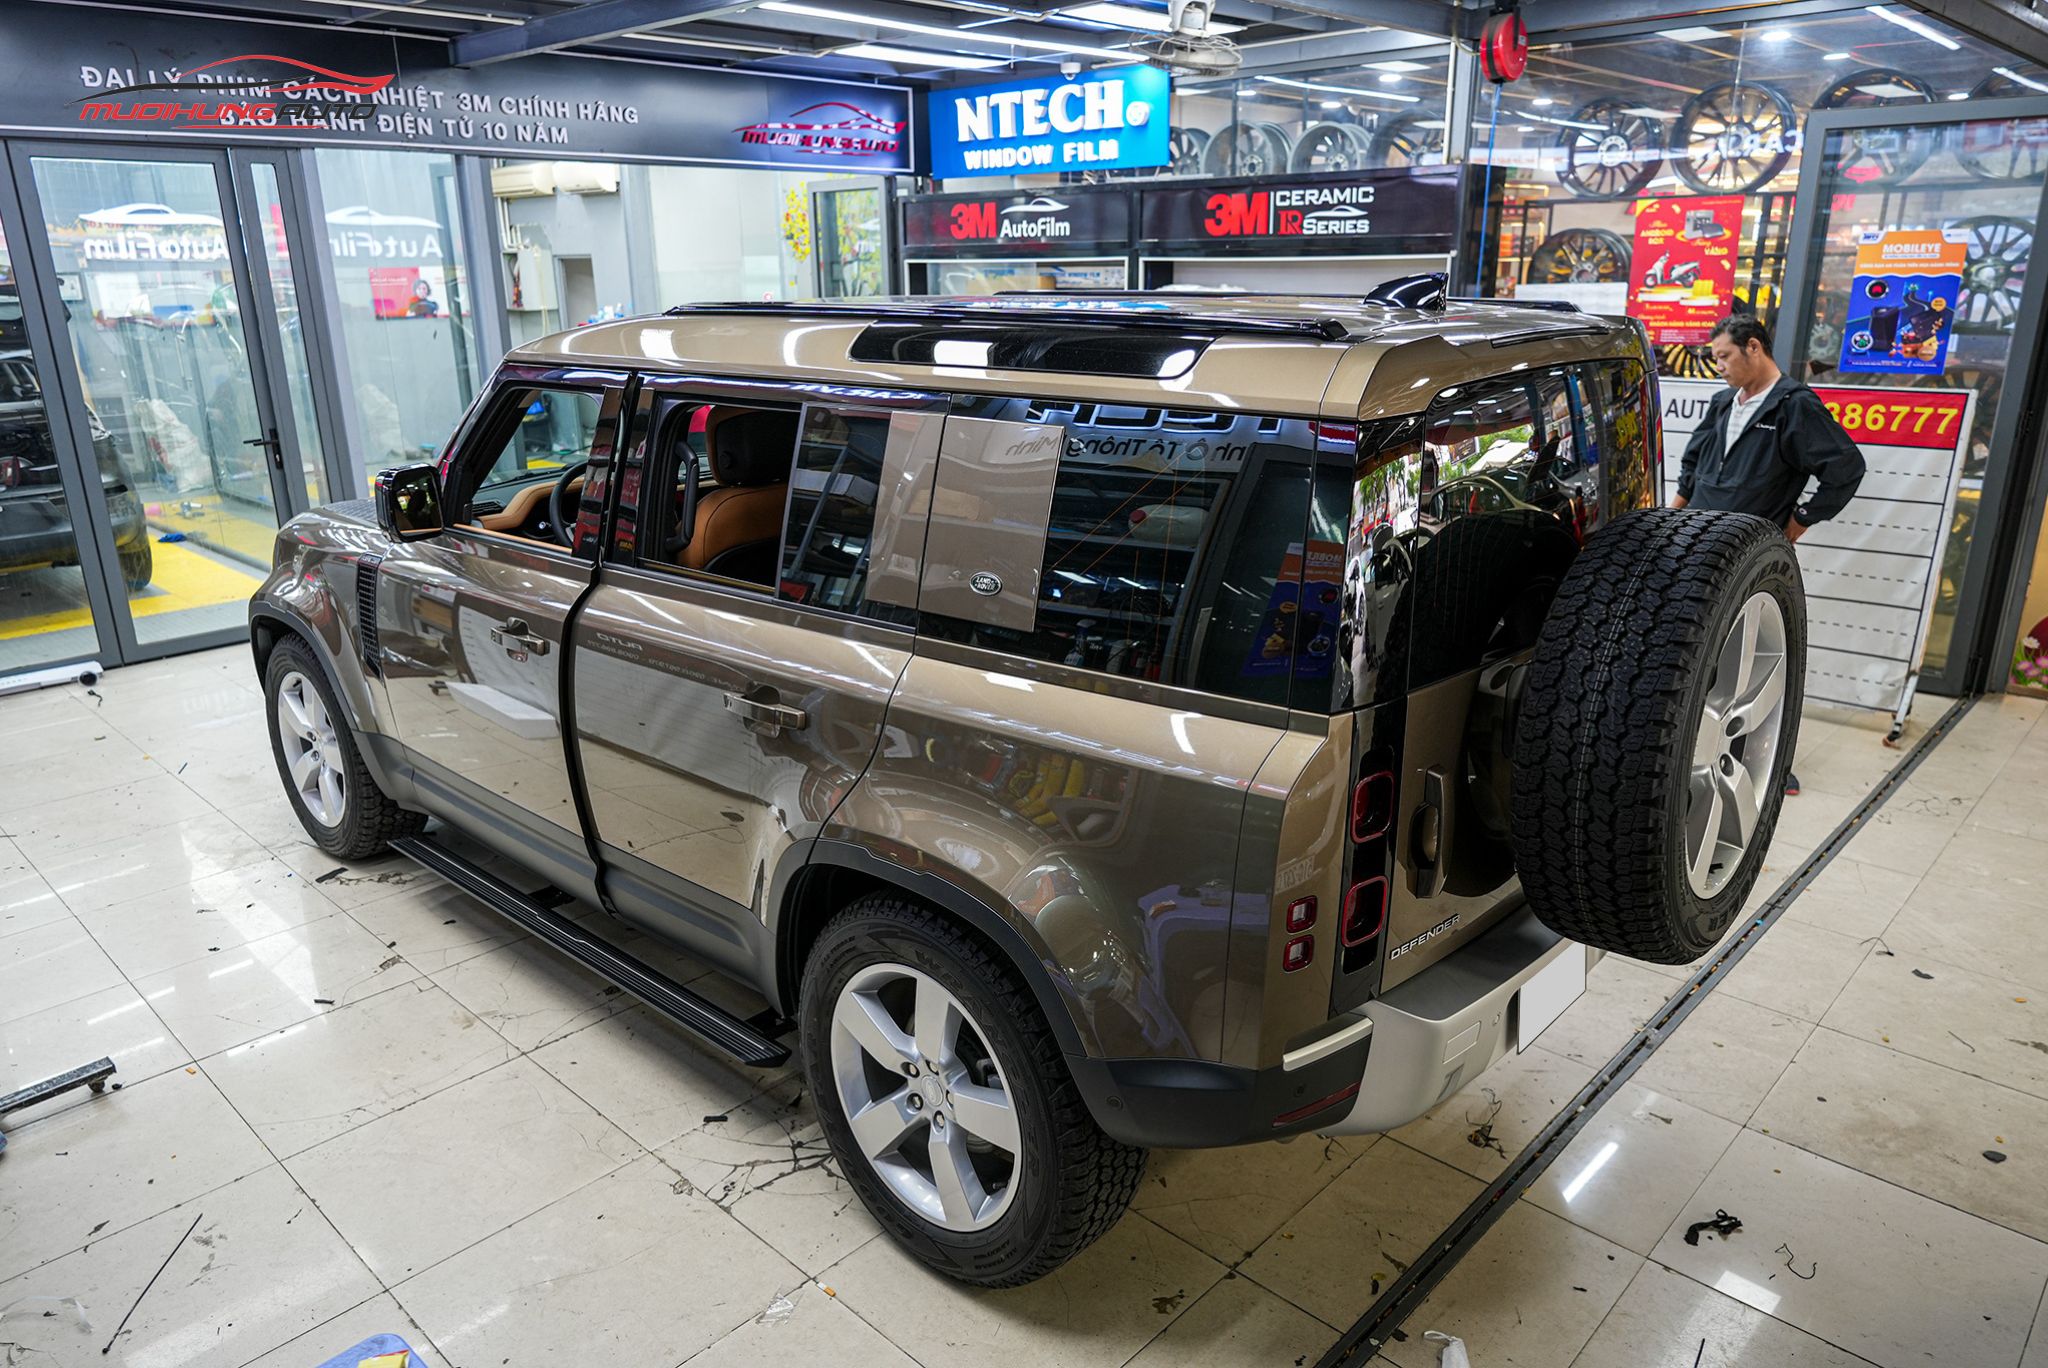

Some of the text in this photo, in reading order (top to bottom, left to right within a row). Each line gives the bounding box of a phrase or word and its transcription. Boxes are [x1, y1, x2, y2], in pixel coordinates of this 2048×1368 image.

[148, 67, 182, 93] LÝ
[198, 74, 271, 98] PHIM
[282, 76, 361, 104] CÁCH
[372, 84, 444, 112] NHIỆT
[458, 93, 492, 113] 3M
[500, 95, 570, 119] CHÍNH
[577, 101, 638, 124] HÃNG
[955, 79, 1126, 143] NTECH
[291, 105, 365, 132] HÀNH
[377, 112, 433, 138] ĐIỆN
[442, 117, 474, 139] TỬ
[482, 122, 508, 140] 10
[515, 121, 568, 144] NĂM
[964, 138, 1120, 170] WINDOW FILM
[951, 202, 1070, 240] 3M AutoFilm
[1204, 186, 1375, 237] 3M CERAMIC
[1302, 218, 1370, 235] SERIES
[1882, 243, 1942, 254] MOBILEYE
[1664, 398, 1709, 419] AUT
[1390, 914, 1461, 960] DEFENDER
